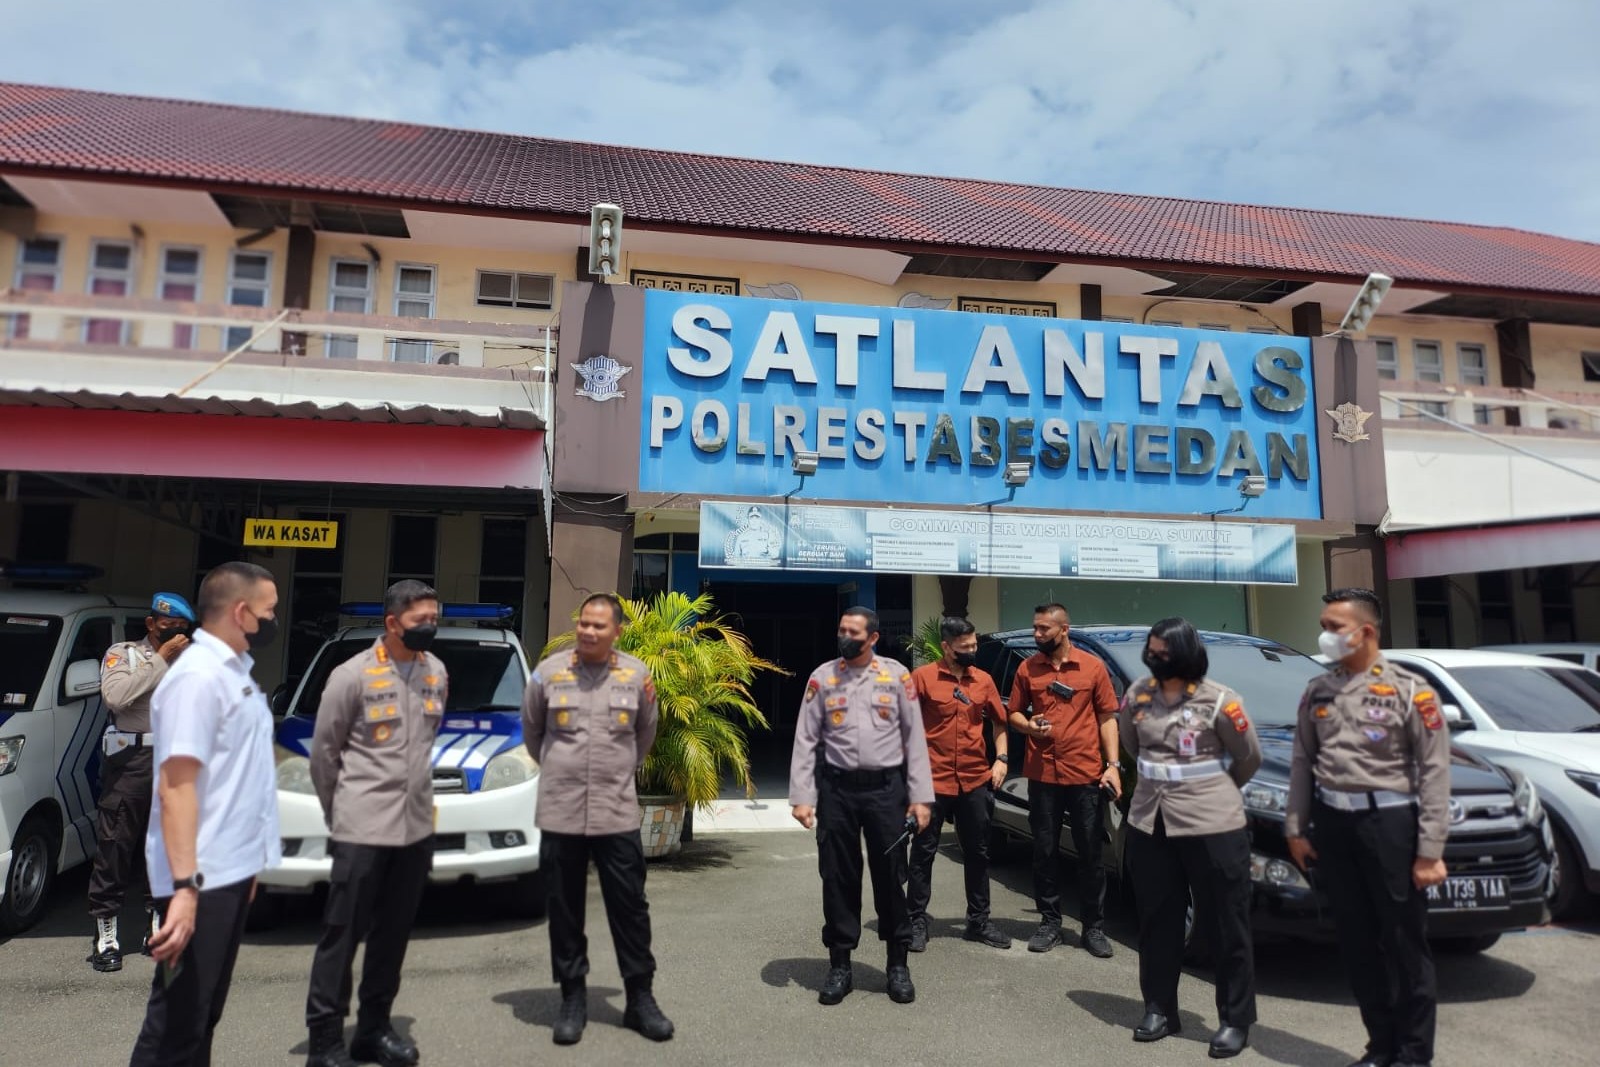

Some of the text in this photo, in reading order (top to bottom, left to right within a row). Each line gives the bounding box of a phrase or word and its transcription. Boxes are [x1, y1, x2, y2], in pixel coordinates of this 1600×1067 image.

[667, 303, 1307, 412] SATLANTAS
[253, 525, 330, 542] WA KASAT
[889, 517, 1232, 543] COMMANDER WISH KAPOLDA SUMUT
[1362, 697, 1396, 708] POLRI
[1445, 879, 1476, 899] 1739
[1480, 879, 1505, 898] YAA
